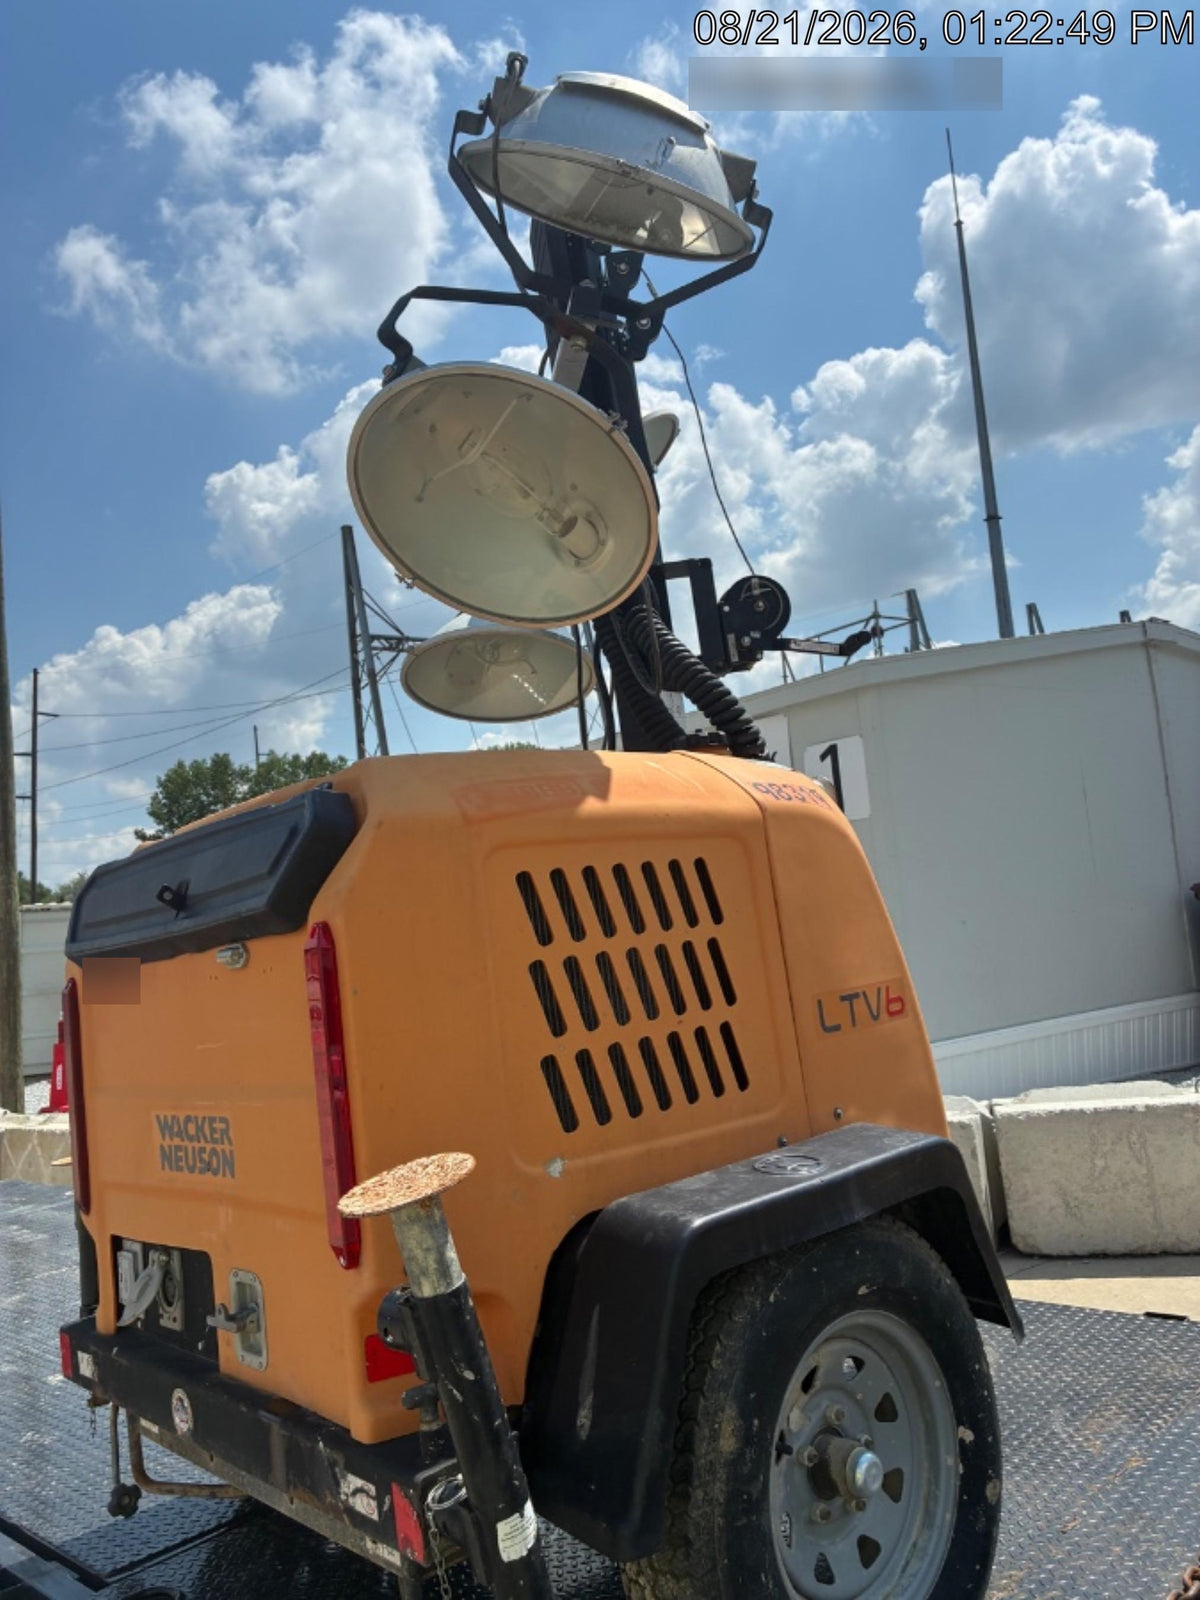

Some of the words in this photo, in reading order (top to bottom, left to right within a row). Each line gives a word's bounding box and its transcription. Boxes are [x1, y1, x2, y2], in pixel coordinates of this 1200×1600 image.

[819, 743, 845, 814] 1
[817, 985, 906, 1033] LTV6
[155, 1113, 234, 1147] WACKER
[159, 1143, 236, 1179] NEUSON
